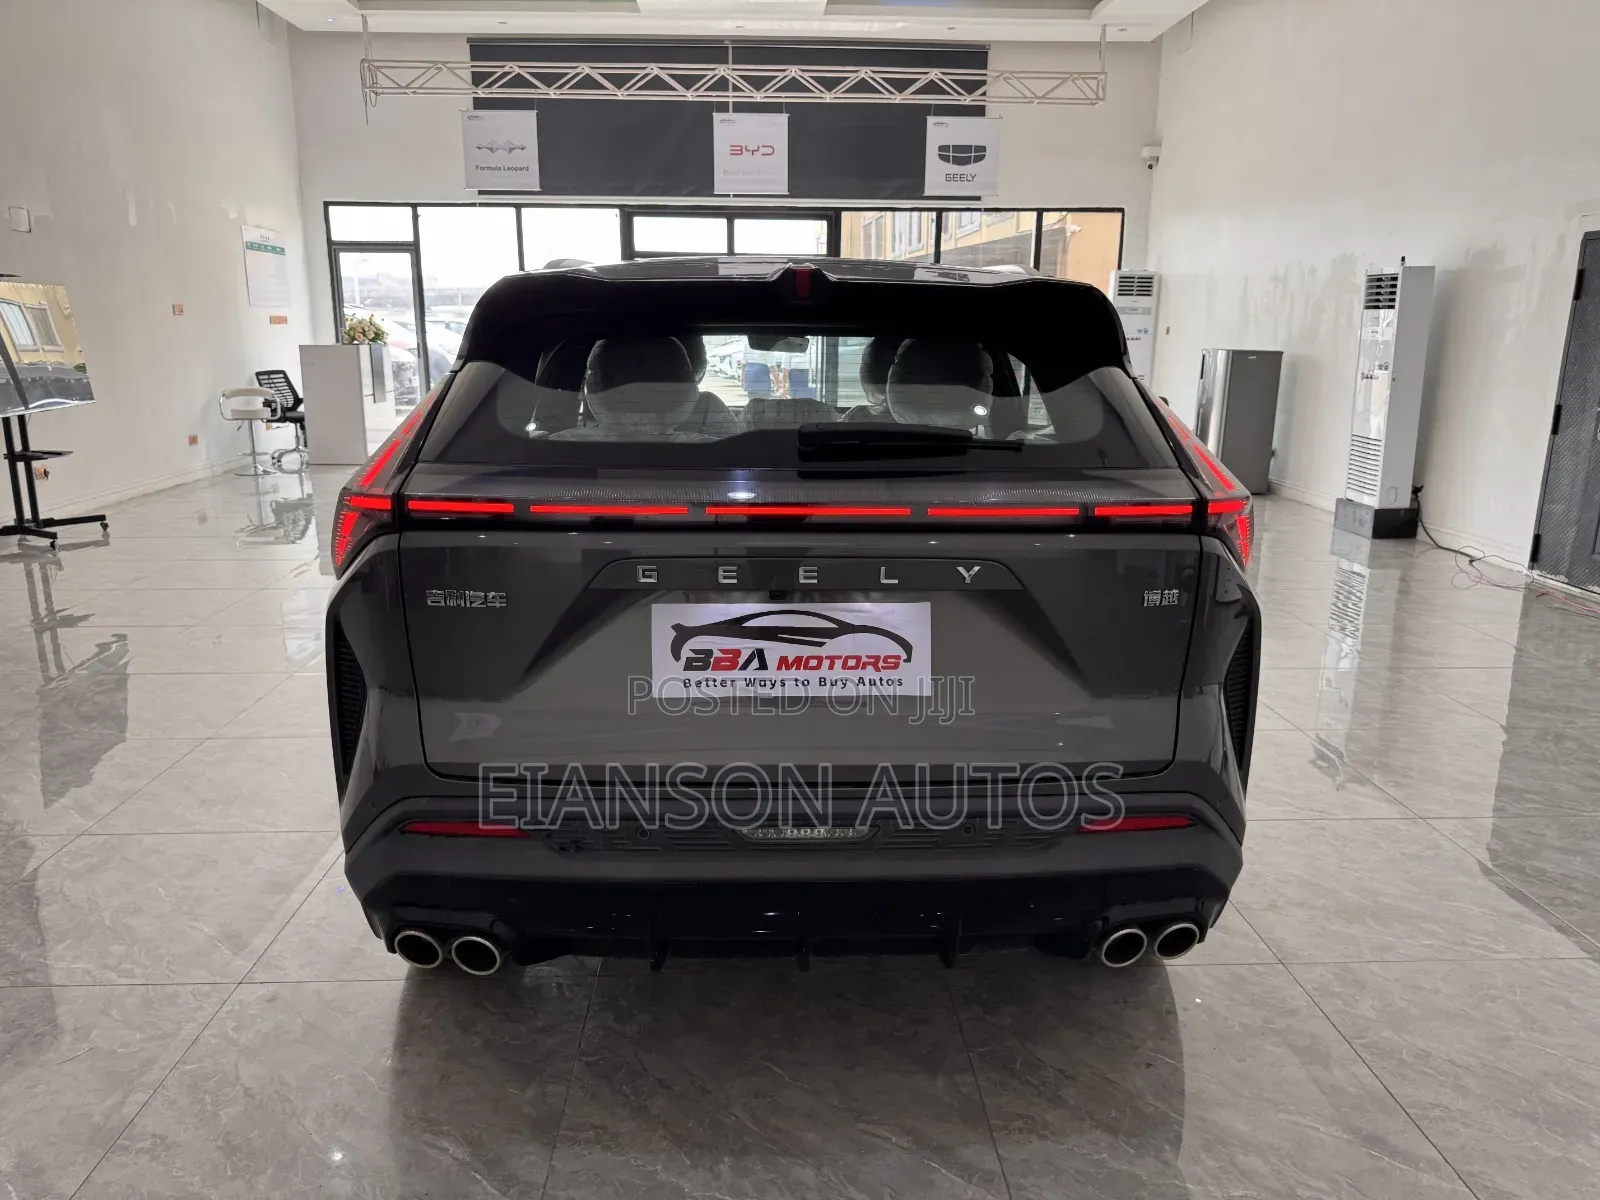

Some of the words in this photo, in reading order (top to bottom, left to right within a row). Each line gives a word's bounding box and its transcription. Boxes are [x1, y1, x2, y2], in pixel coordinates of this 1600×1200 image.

[729, 144, 775, 156] BYD
[475, 164, 501, 172] Formula
[503, 165, 529, 173] Leopard
[945, 173, 977, 182] GEELY
[636, 565, 981, 584] GEELY
[425, 589, 507, 608] 吉利汽车
[682, 648, 769, 672] BBA
[776, 654, 902, 673] MOTORS
[683, 677, 736, 689] Better
[744, 677, 787, 690] Ways
[794, 676, 811, 688] to
[818, 676, 848, 690] Buy
[856, 676, 904, 688] Autos
